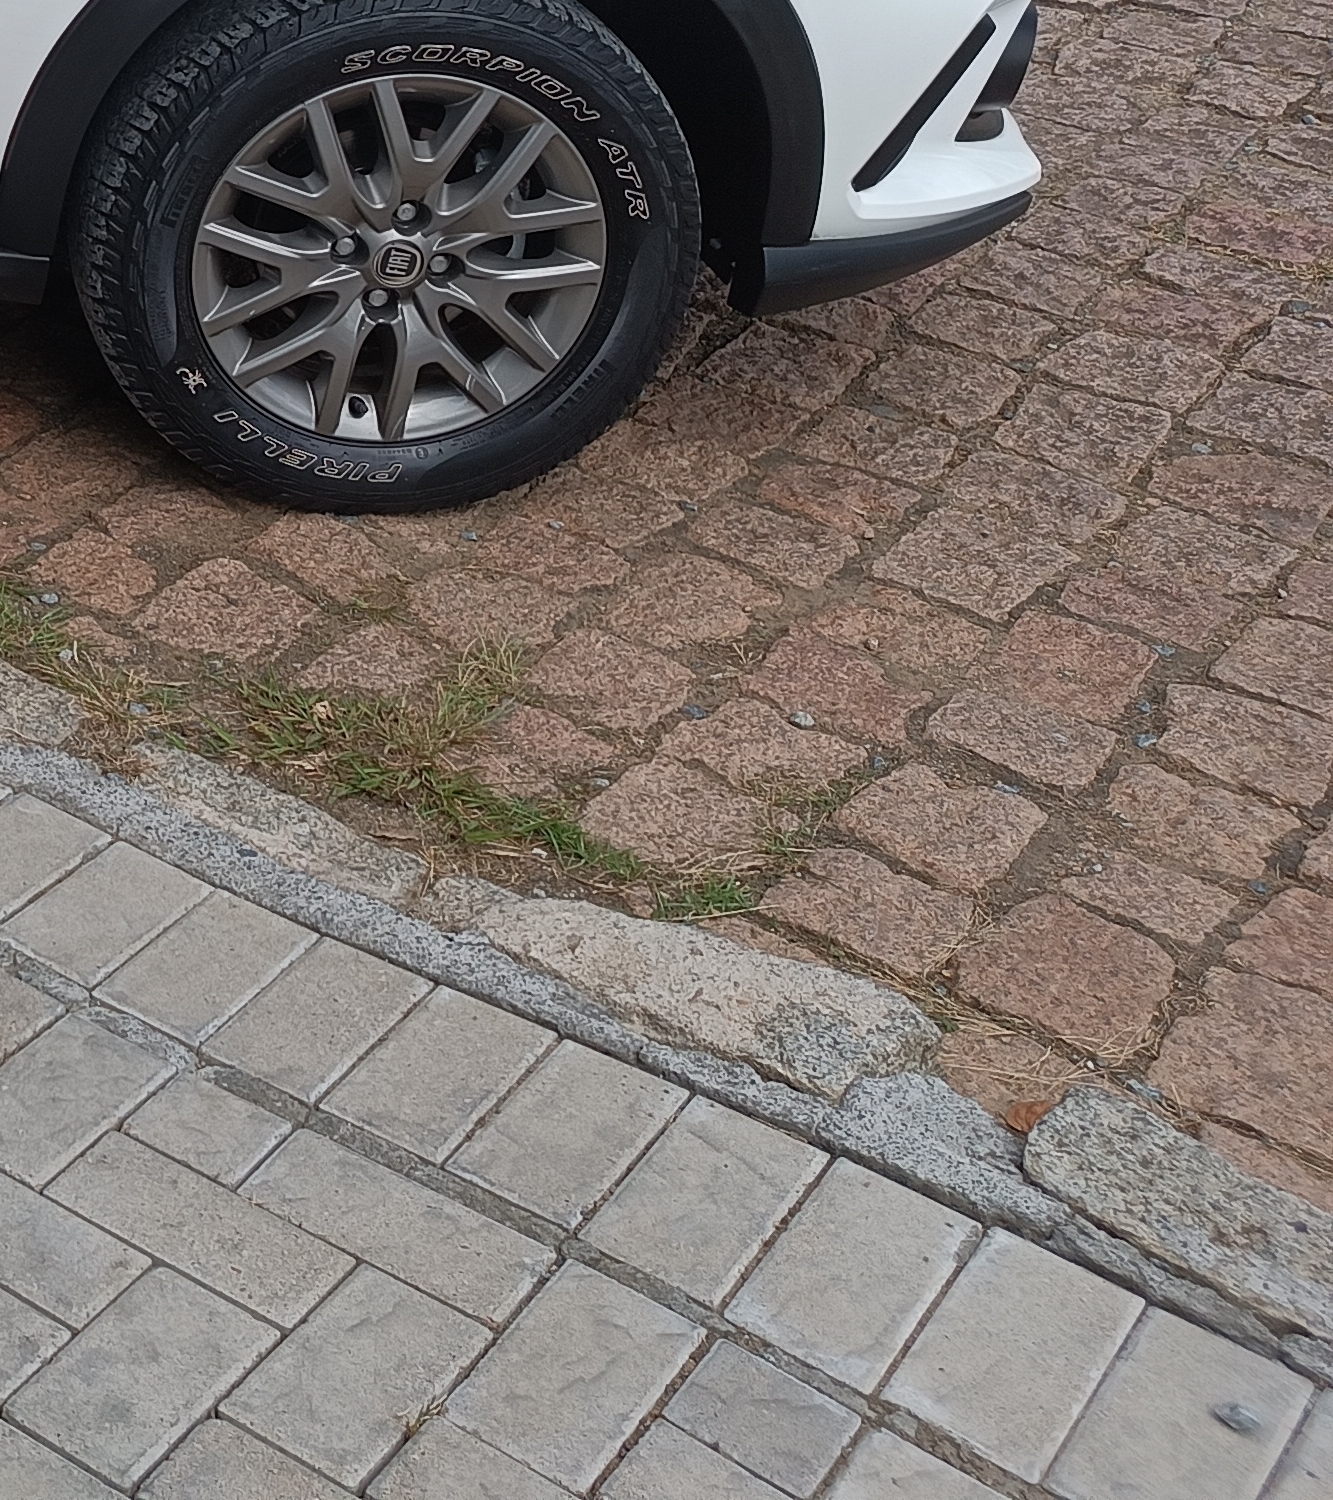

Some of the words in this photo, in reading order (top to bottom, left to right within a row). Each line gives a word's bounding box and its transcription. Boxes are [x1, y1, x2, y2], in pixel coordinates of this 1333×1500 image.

[340, 43, 601, 123] SCORPION
[598, 137, 650, 221] ATR
[385, 248, 412, 276] FIAT
[213, 408, 405, 483] PIRELLI
